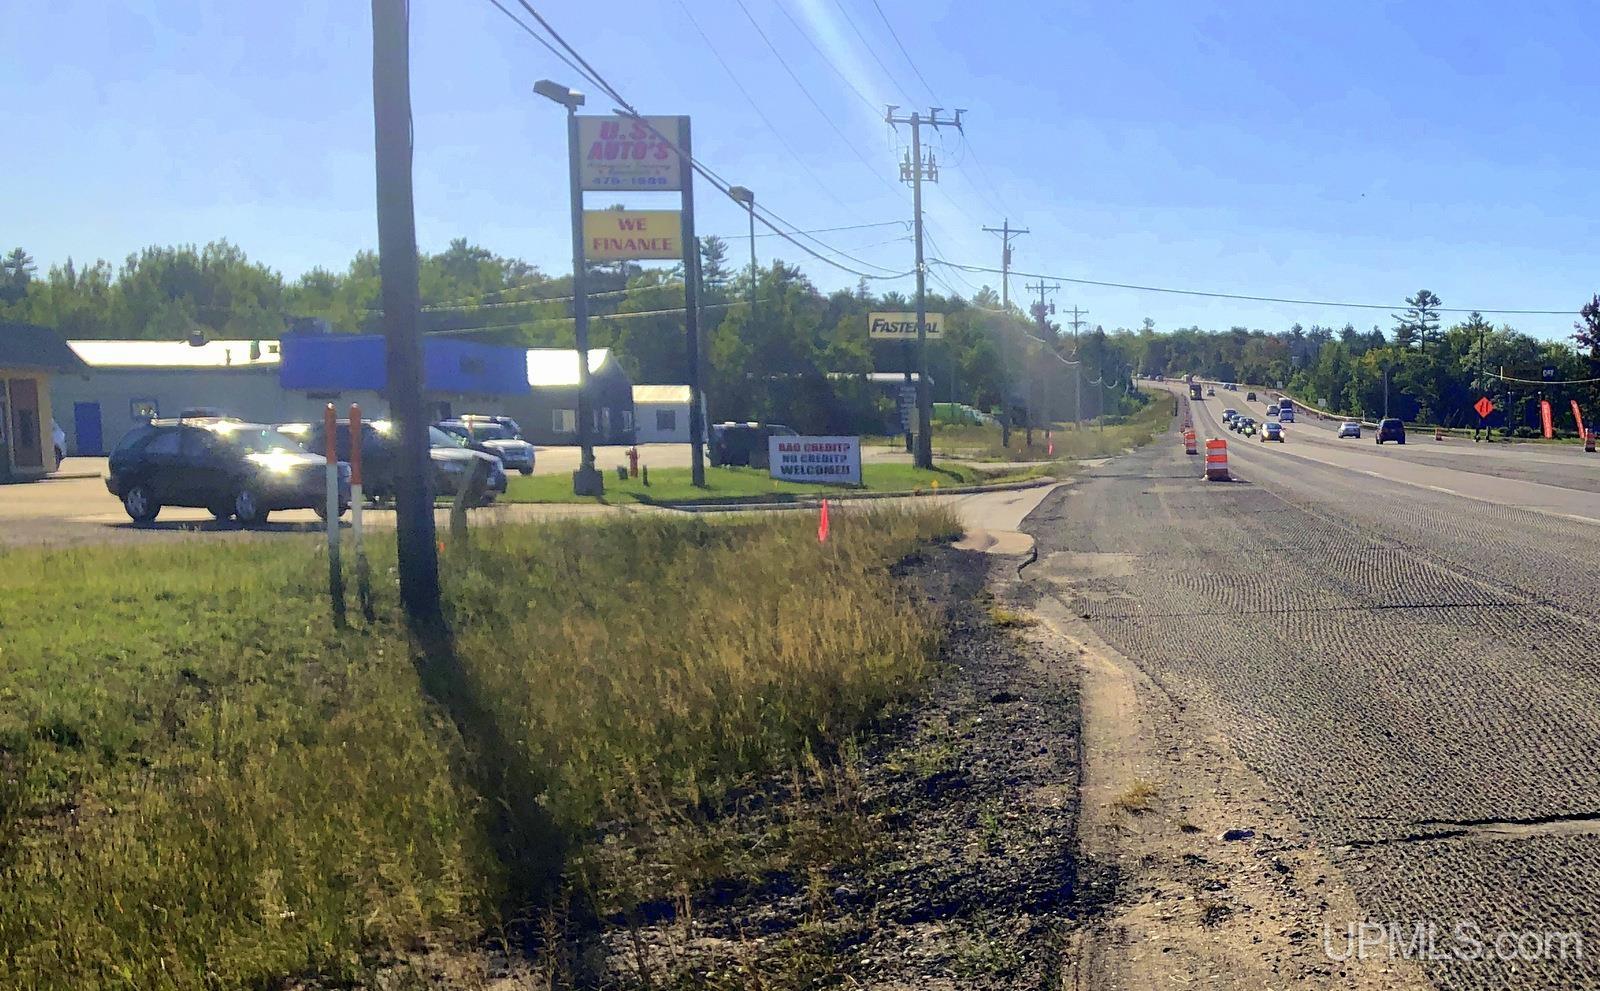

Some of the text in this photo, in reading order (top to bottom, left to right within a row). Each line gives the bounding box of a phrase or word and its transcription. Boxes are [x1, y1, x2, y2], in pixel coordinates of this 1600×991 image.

[599, 118, 656, 140] U.S.
[587, 141, 669, 160] AUTO'S
[617, 218, 647, 231] WE
[592, 238, 672, 250] FINANCE
[871, 318, 940, 333] FASTEAL
[778, 442, 801, 452] BAD
[782, 454, 798, 463] NO
